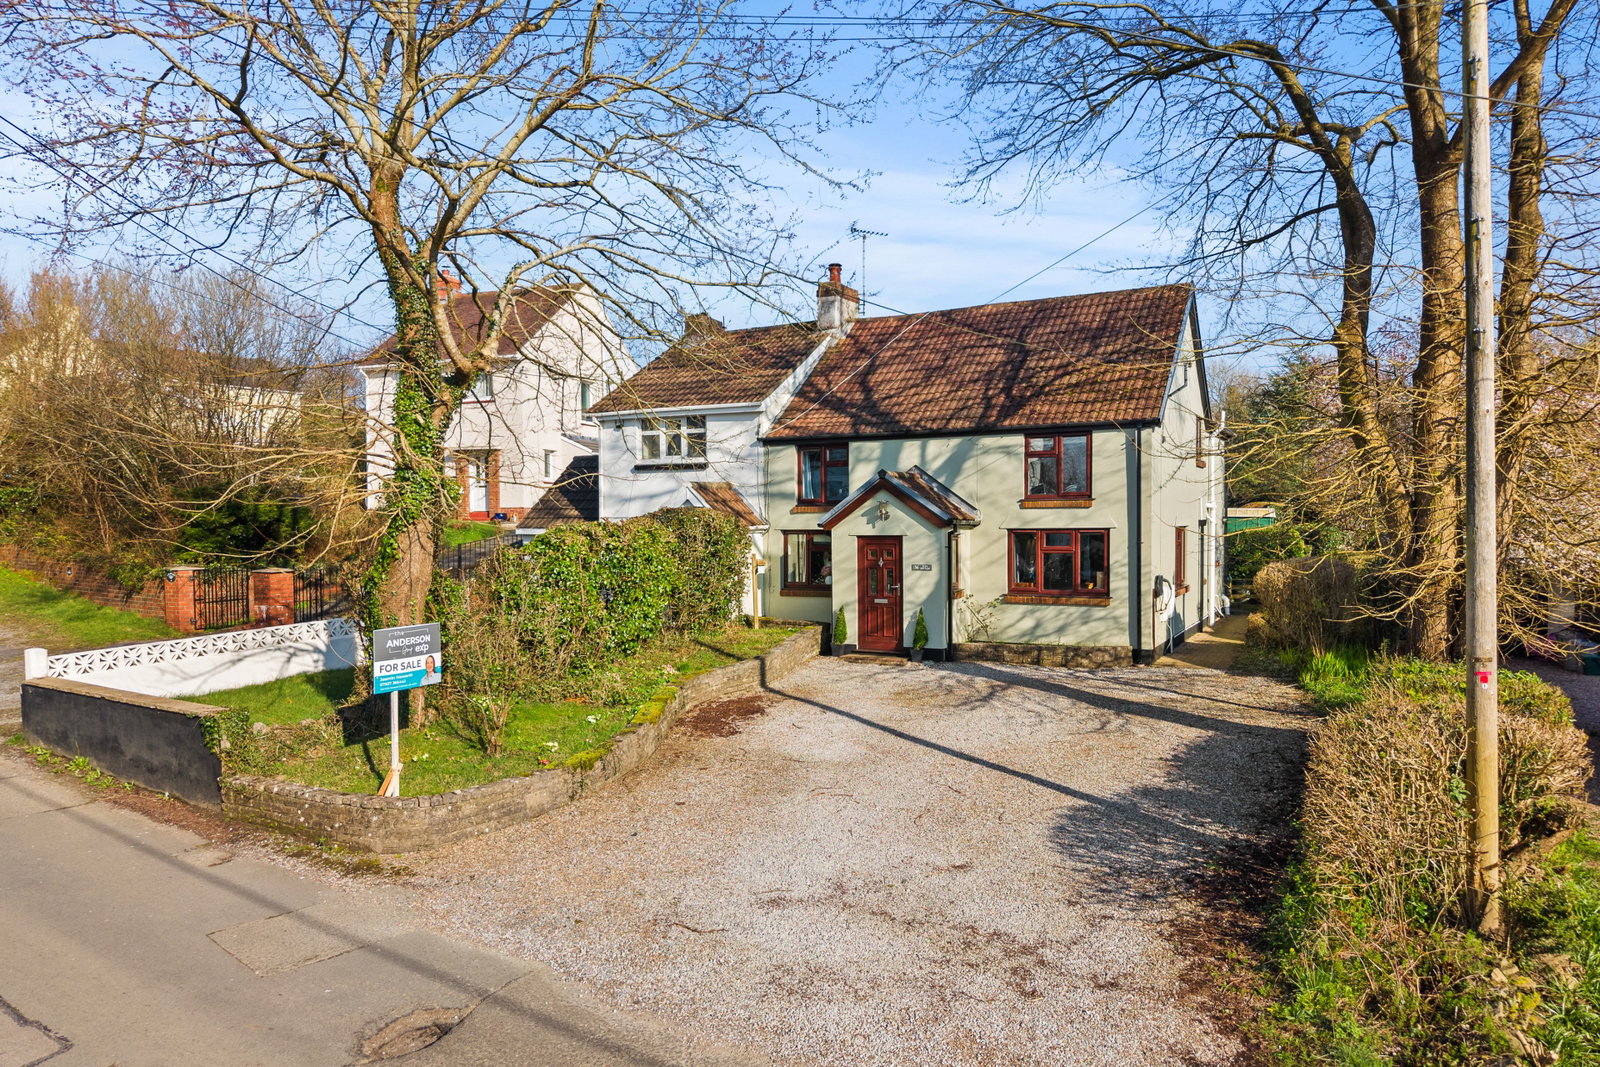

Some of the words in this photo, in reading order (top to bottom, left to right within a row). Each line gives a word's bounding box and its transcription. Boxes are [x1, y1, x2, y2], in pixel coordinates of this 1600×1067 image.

[386, 634, 431, 648] ANDERSON
[415, 643, 429, 653] exp
[380, 663, 398, 674] FOR
[400, 659, 421, 671] SALE
